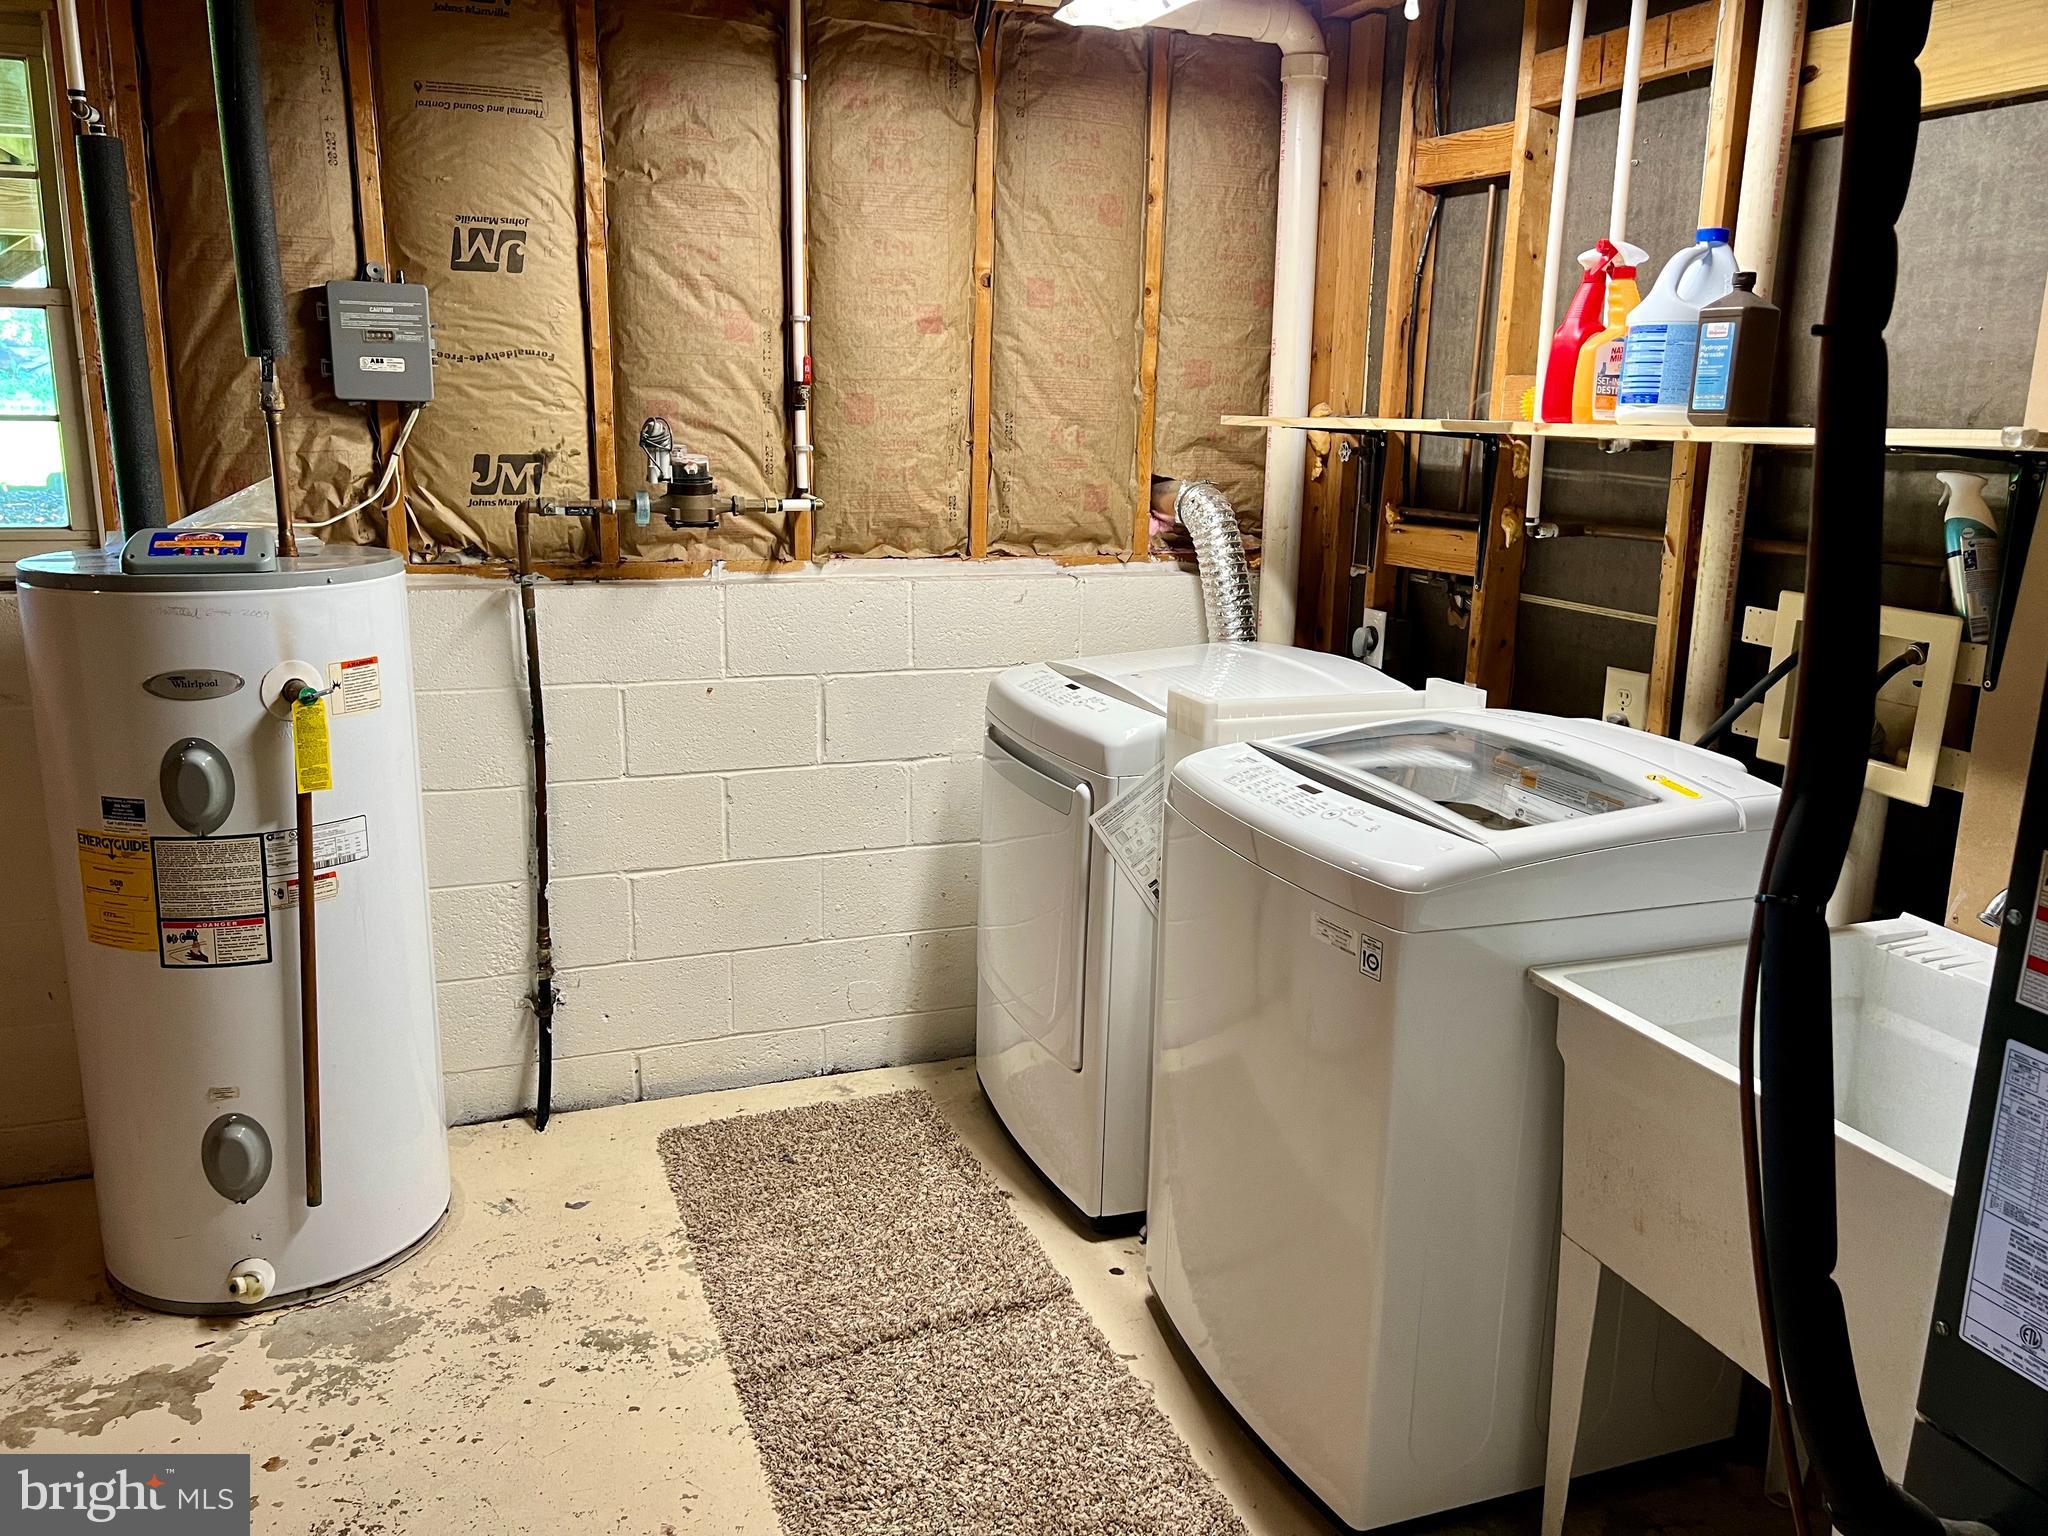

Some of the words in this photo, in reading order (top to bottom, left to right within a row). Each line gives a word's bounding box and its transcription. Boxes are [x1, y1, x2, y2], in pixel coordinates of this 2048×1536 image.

[432, 2, 464, 14] Johns
[465, 6, 510, 18] Manville
[415, 99, 450, 110] Control
[453, 102, 485, 112] Sound
[486, 105, 504, 114] and
[507, 107, 544, 119] Thermal
[455, 214, 499, 225] Manville
[500, 217, 530, 227] Johns
[451, 226, 527, 274] JM
[436, 349, 555, 364] Formaldehyde-Free
[470, 453, 544, 496] JM
[467, 498, 497, 508] Johns
[170, 679, 219, 690] Whirlpool
[77, 832, 150, 855] ENERGYGUIDE
